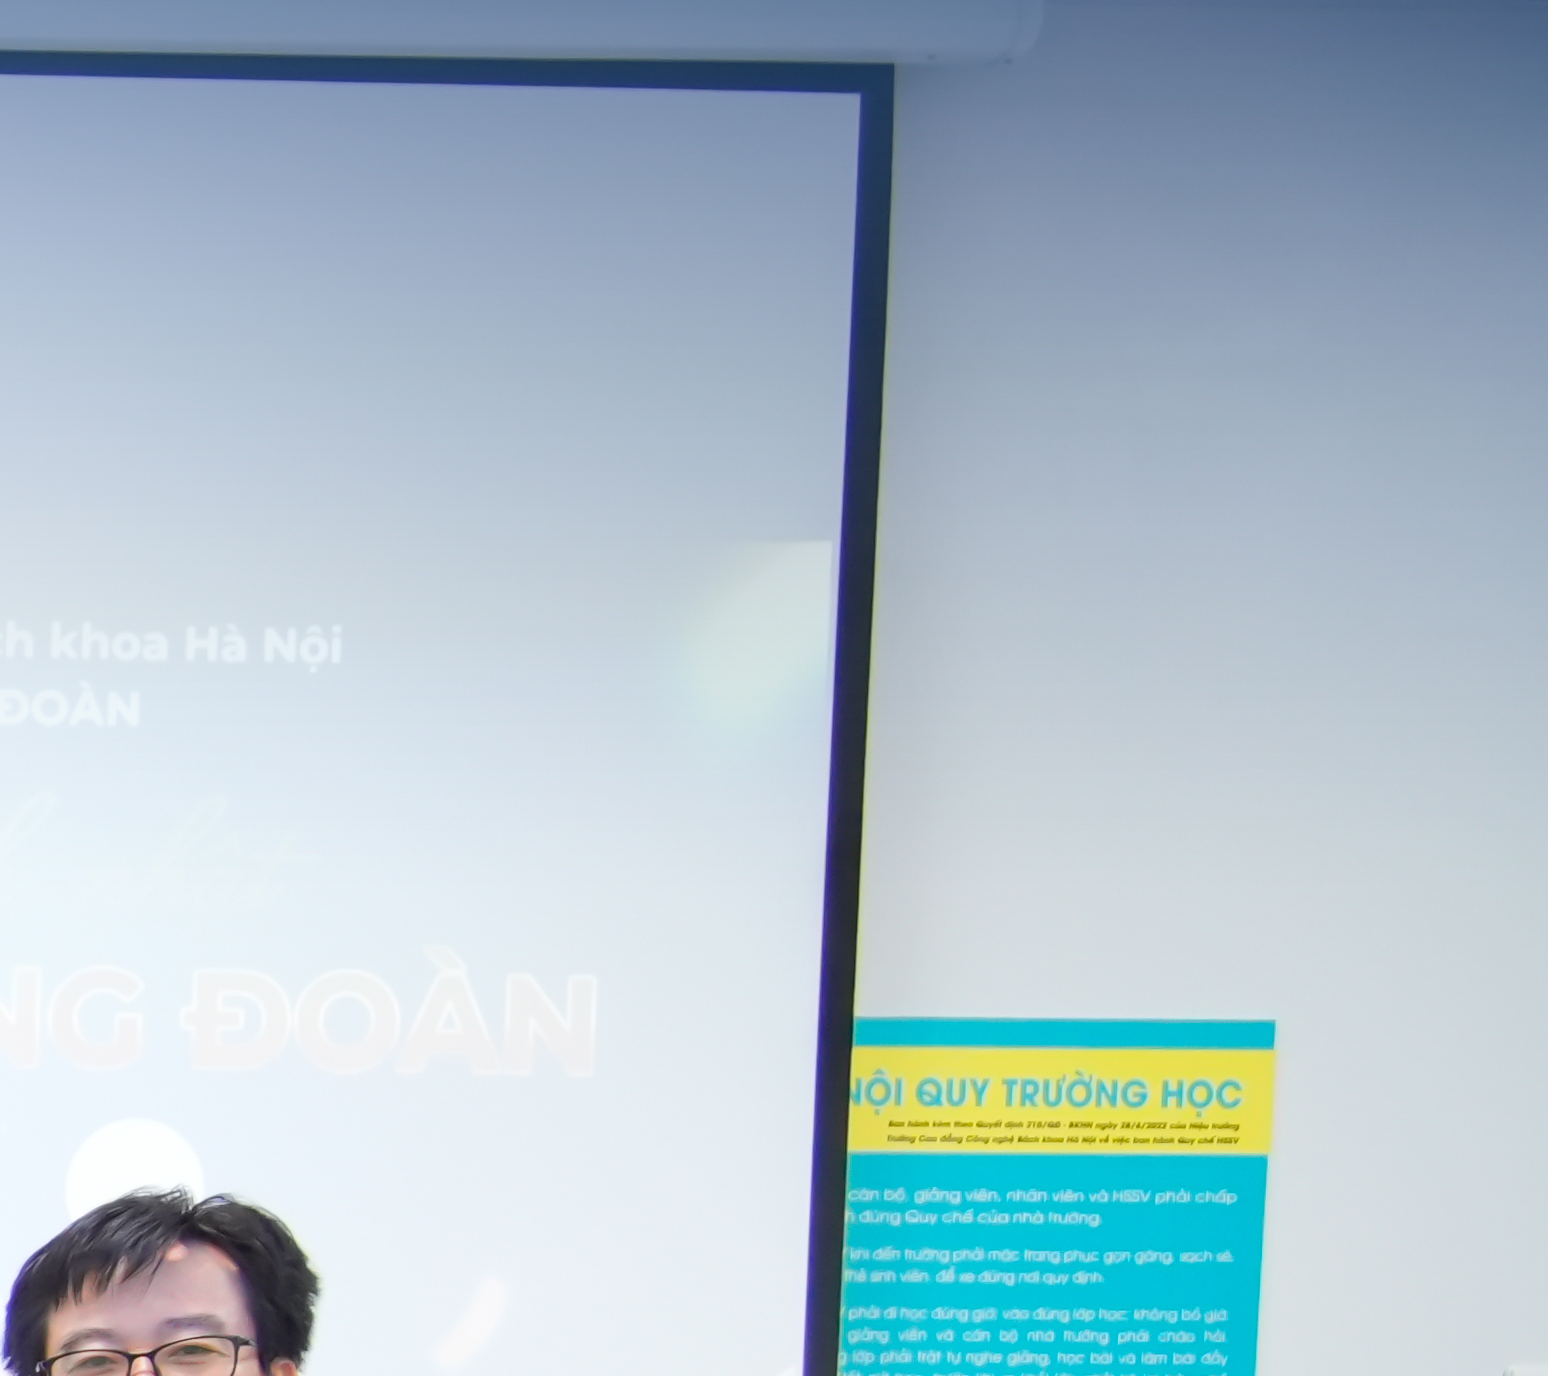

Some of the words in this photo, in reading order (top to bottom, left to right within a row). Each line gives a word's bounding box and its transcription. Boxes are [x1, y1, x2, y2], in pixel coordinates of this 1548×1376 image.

[50, 618, 169, 664] khoa
[184, 619, 246, 665] Hà
[264, 619, 343, 674] Nội
[179, 941, 598, 1079] ĐOÀN
[850, 1069, 902, 1115] NỘI
[917, 1078, 990, 1109] QUY
[1003, 1070, 1148, 1108] TRƯỜNG
[1162, 1078, 1242, 1116] HỌC
